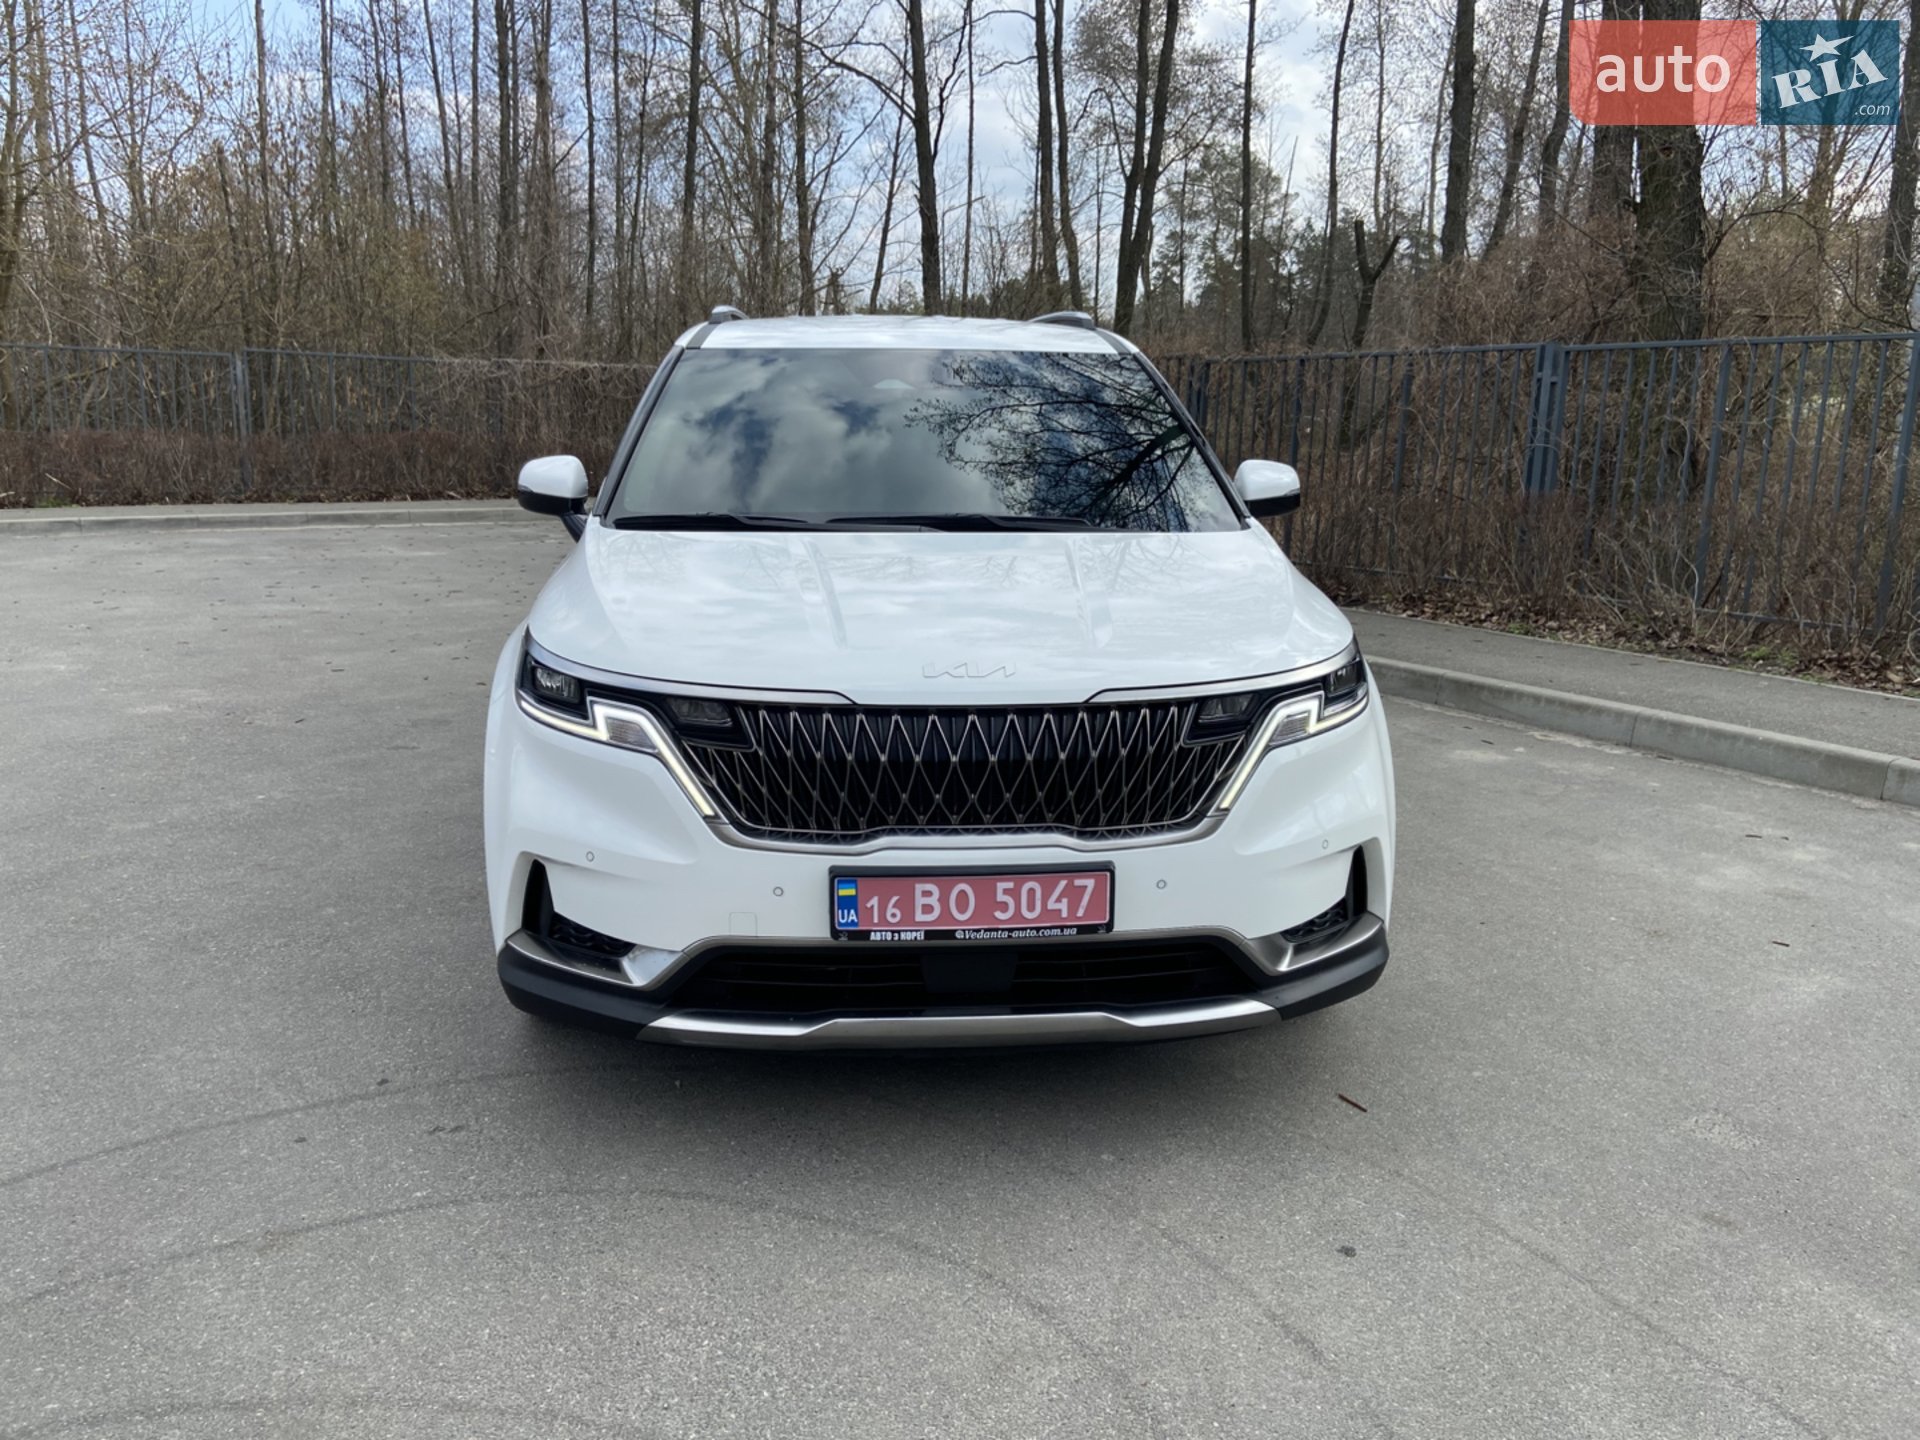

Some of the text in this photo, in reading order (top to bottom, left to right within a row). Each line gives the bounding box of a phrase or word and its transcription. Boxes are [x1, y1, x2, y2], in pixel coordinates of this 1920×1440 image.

[865, 878, 1095, 924] 16 BO 5047
[838, 909, 858, 924] UA
[870, 928, 892, 941] АВТО
[900, 927, 925, 941] КОРЕЇ
